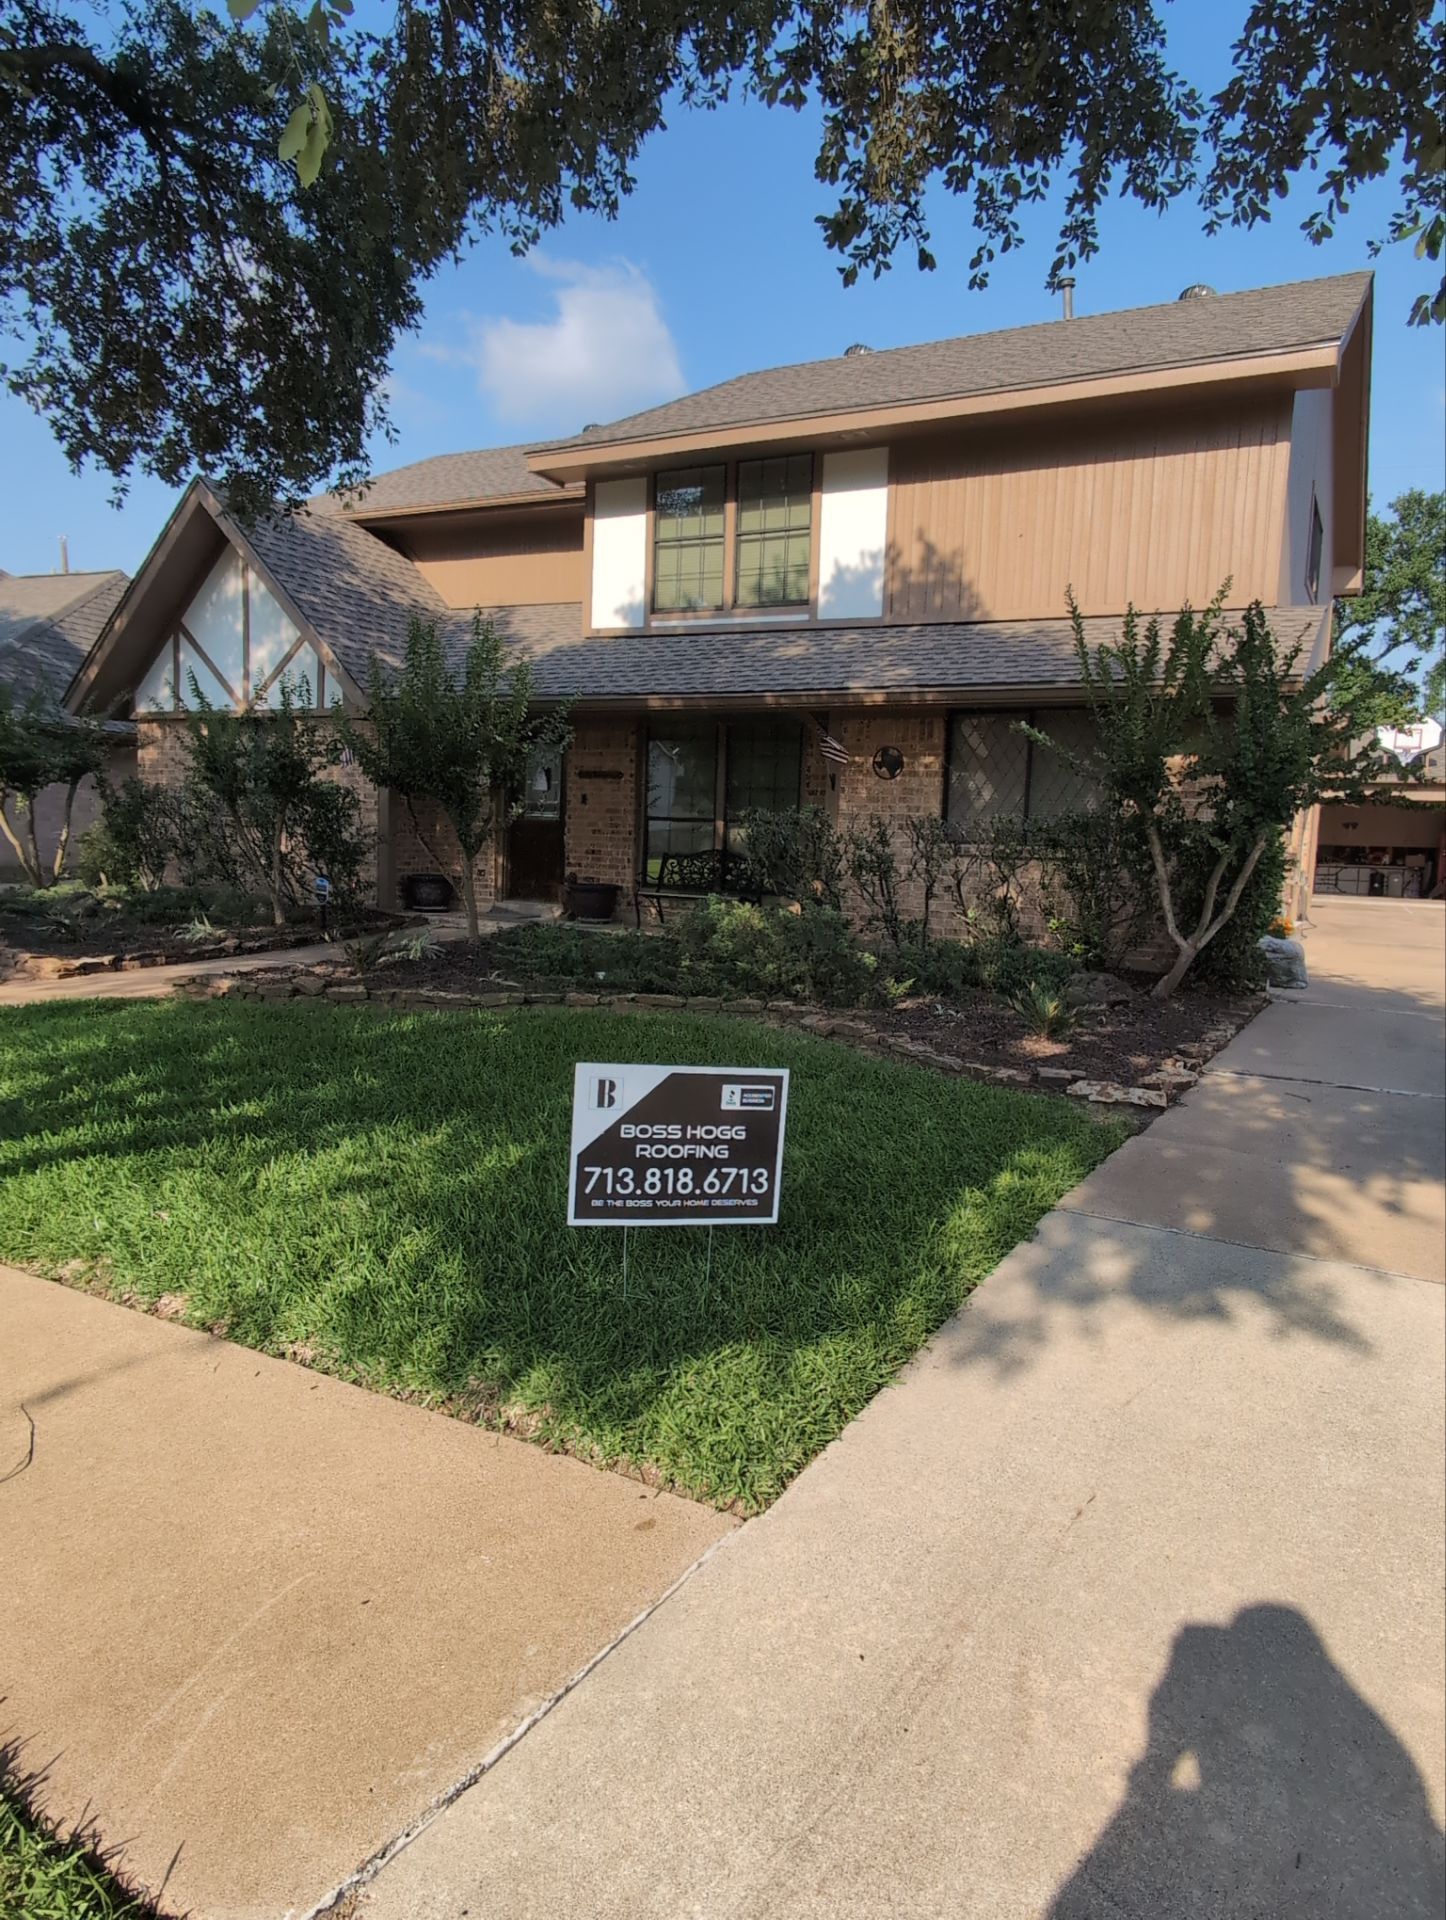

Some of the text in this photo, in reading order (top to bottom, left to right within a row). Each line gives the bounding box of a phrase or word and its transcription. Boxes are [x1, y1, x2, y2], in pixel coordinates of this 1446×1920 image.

[597, 1079, 616, 1108] B
[620, 1124, 746, 1140] BOSS HOGG
[635, 1144, 729, 1159] ROOFING
[584, 1167, 768, 1194] 713.818.6713
[591, 1199, 758, 1207] BE THE BOSS YOUR HOME DESERVES
